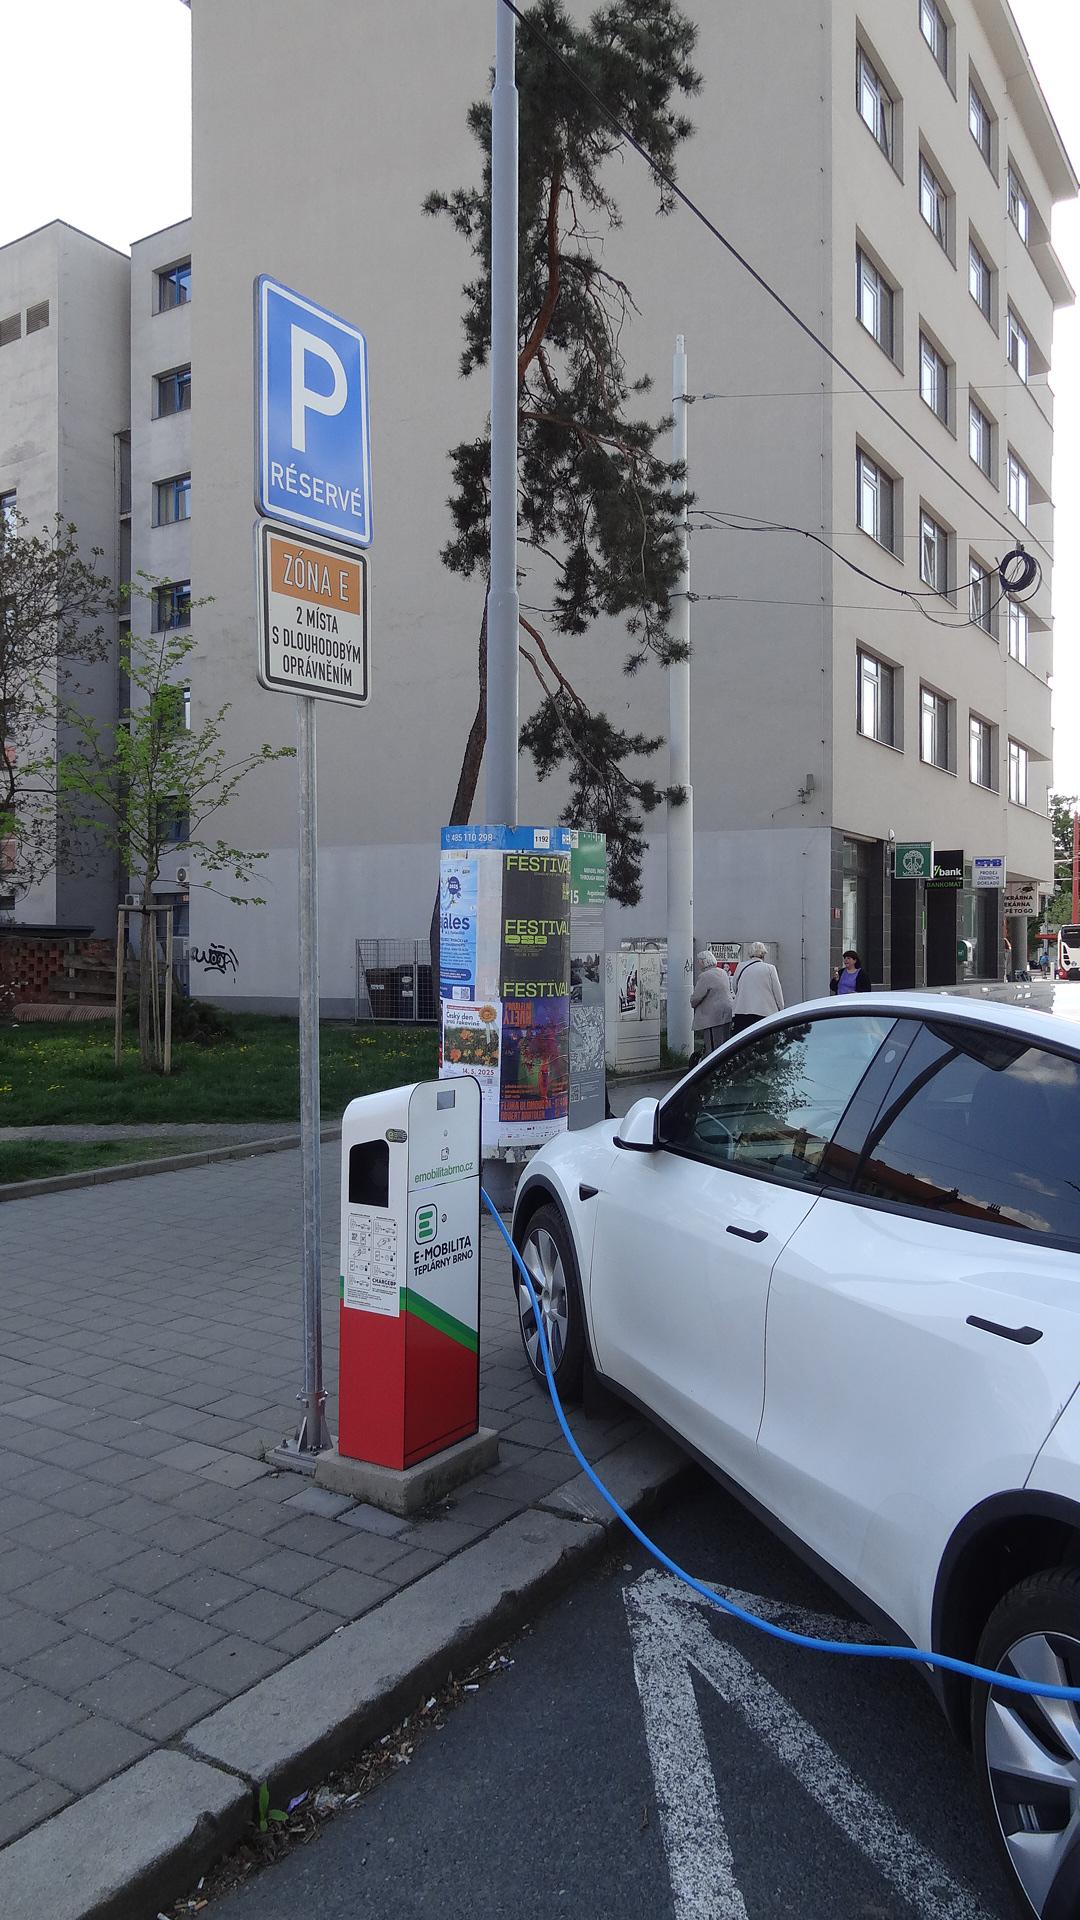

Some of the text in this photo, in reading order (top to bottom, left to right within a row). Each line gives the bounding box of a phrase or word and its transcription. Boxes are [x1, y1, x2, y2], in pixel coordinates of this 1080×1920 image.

[291, 324, 348, 453] P
[271, 460, 362, 517] RÉSERVÉ
[283, 550, 350, 602] ZÓNA E
[296, 605, 338, 635] 2 MÍSTA
[272, 629, 361, 665] S DLOUHODOBÝM
[282, 654, 352, 687] OPRÁVNĚNÍM
[452, 832, 492, 842] 485 110 298
[505, 919, 570, 936] FESTIVAL
[503, 982, 570, 997] FESTIVAL
[414, 1161, 474, 1184] emobilitabrno.cz
[414, 1236, 471, 1264] E-MOBILITA
[414, 1249, 474, 1276] TEPLÁRNY BRNO
